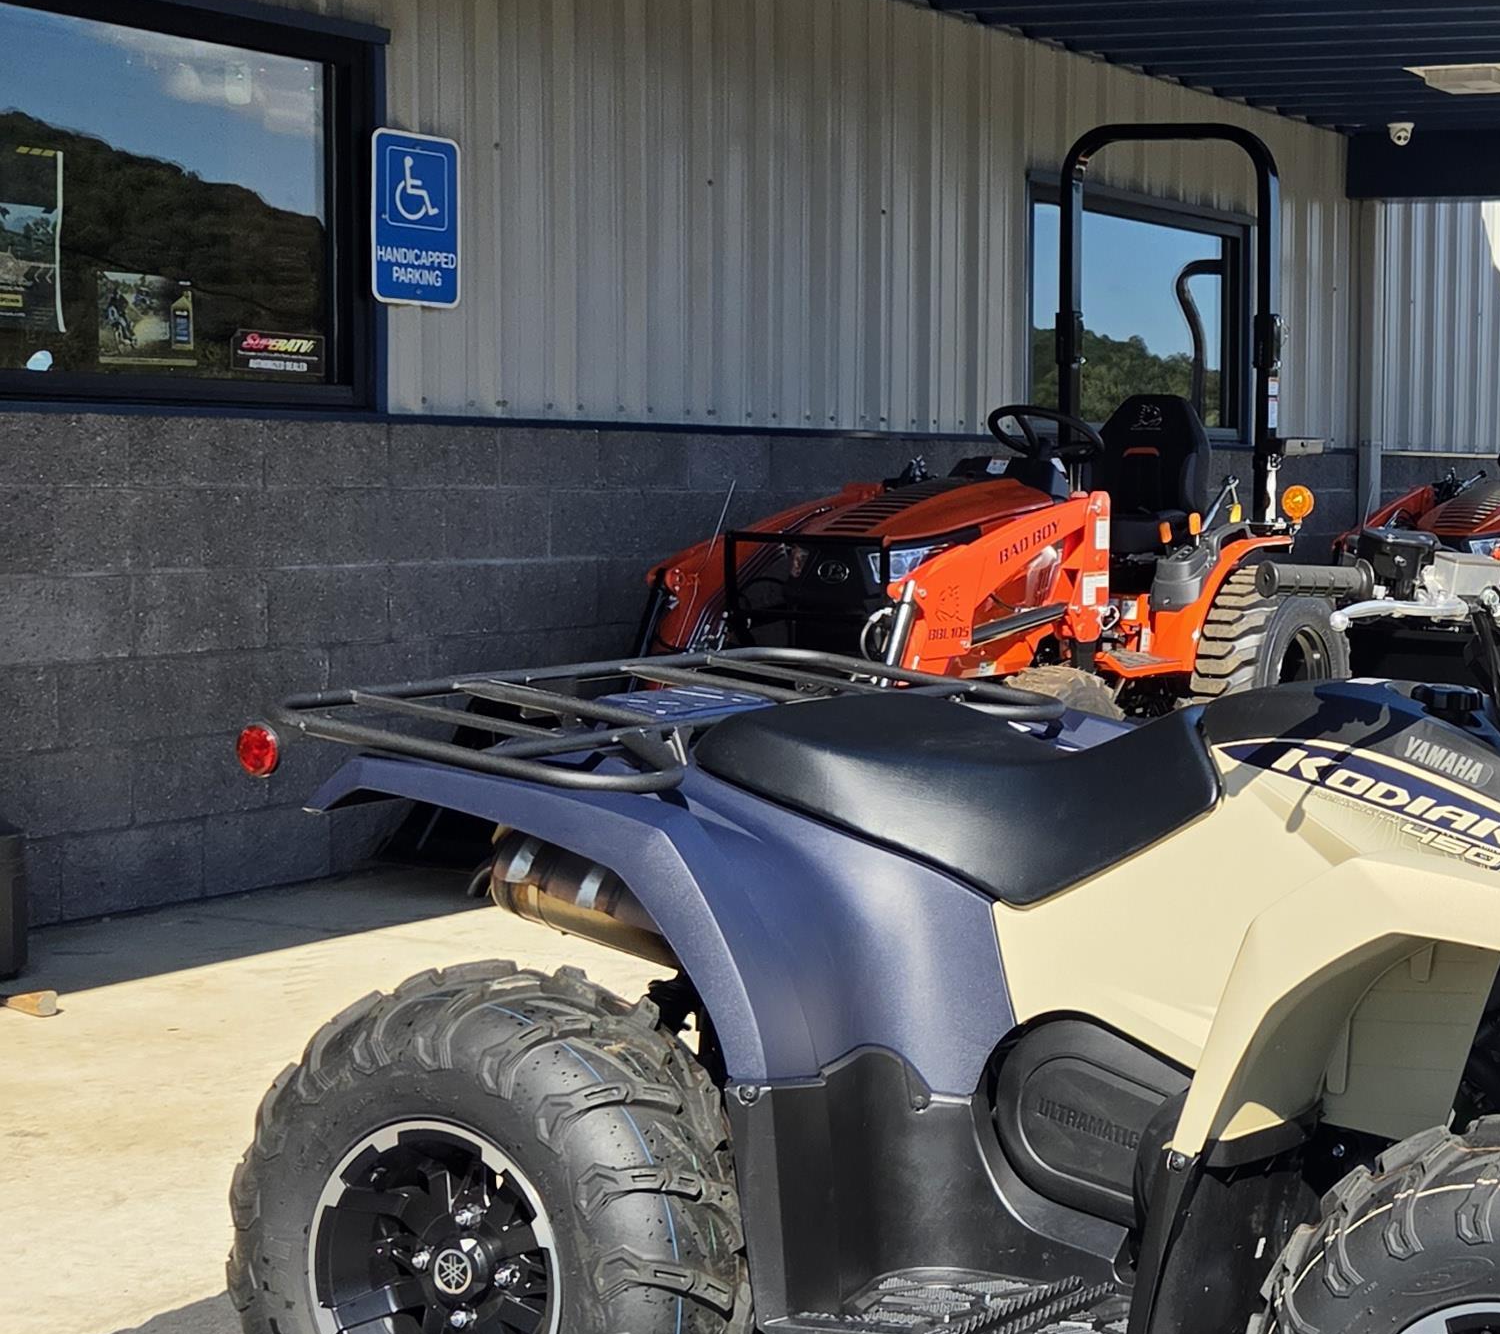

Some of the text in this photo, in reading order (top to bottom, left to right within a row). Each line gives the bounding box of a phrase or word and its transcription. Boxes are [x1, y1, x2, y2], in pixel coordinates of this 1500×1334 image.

[377, 246, 457, 269] HANDICAPPED
[392, 266, 442, 287] PARKING
[1000, 536, 1029, 565] BAD
[1032, 519, 1061, 547] BOY
[1403, 735, 1486, 785] YAMAHA
[1036, 1097, 1140, 1152] ULTRAMATIC
